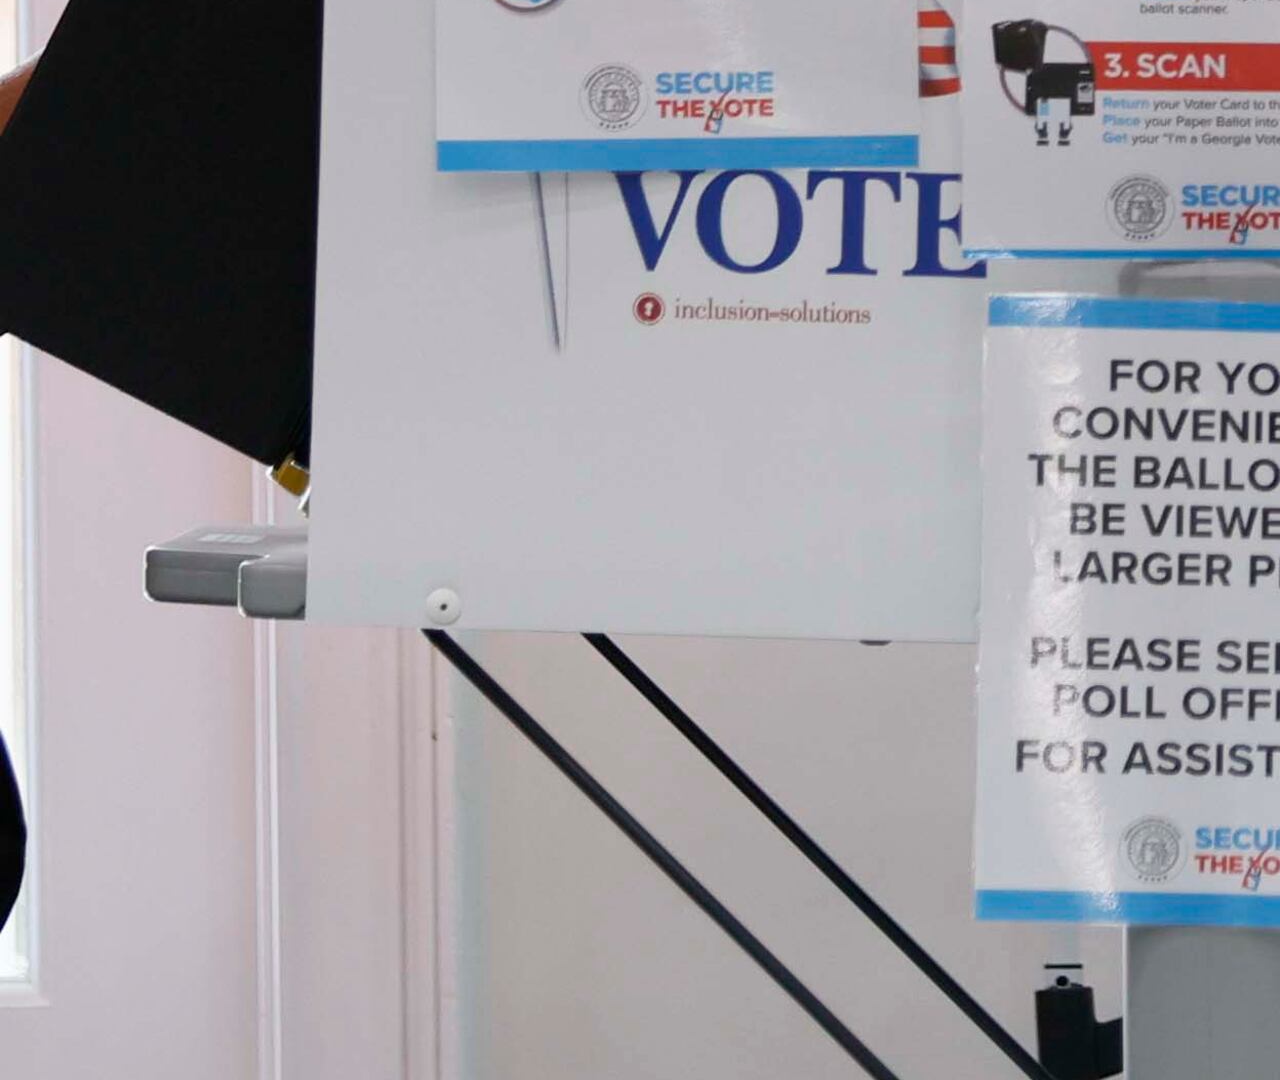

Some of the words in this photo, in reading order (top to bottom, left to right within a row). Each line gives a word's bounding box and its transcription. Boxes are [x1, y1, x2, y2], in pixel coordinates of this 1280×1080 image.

[1140, 2, 1174, 15] ballot
[1178, 3, 1228, 15] scanner.
[1104, 52, 1129, 79] 3.
[1137, 53, 1226, 79] SCAN
[655, 71, 774, 94] SECURE
[656, 99, 705, 118] THE
[1132, 133, 1159, 146] your
[611, 169, 988, 278] VOTE
[1182, 212, 1231, 230] THE
[1110, 358, 1200, 394] FOR
[1028, 453, 1116, 488] THE
[1070, 502, 1125, 536] BE
[1031, 637, 1200, 673] PLEASE
[1055, 684, 1166, 719] POLL
[1015, 739, 1107, 774] FOR
[1195, 855, 1245, 875] THE
